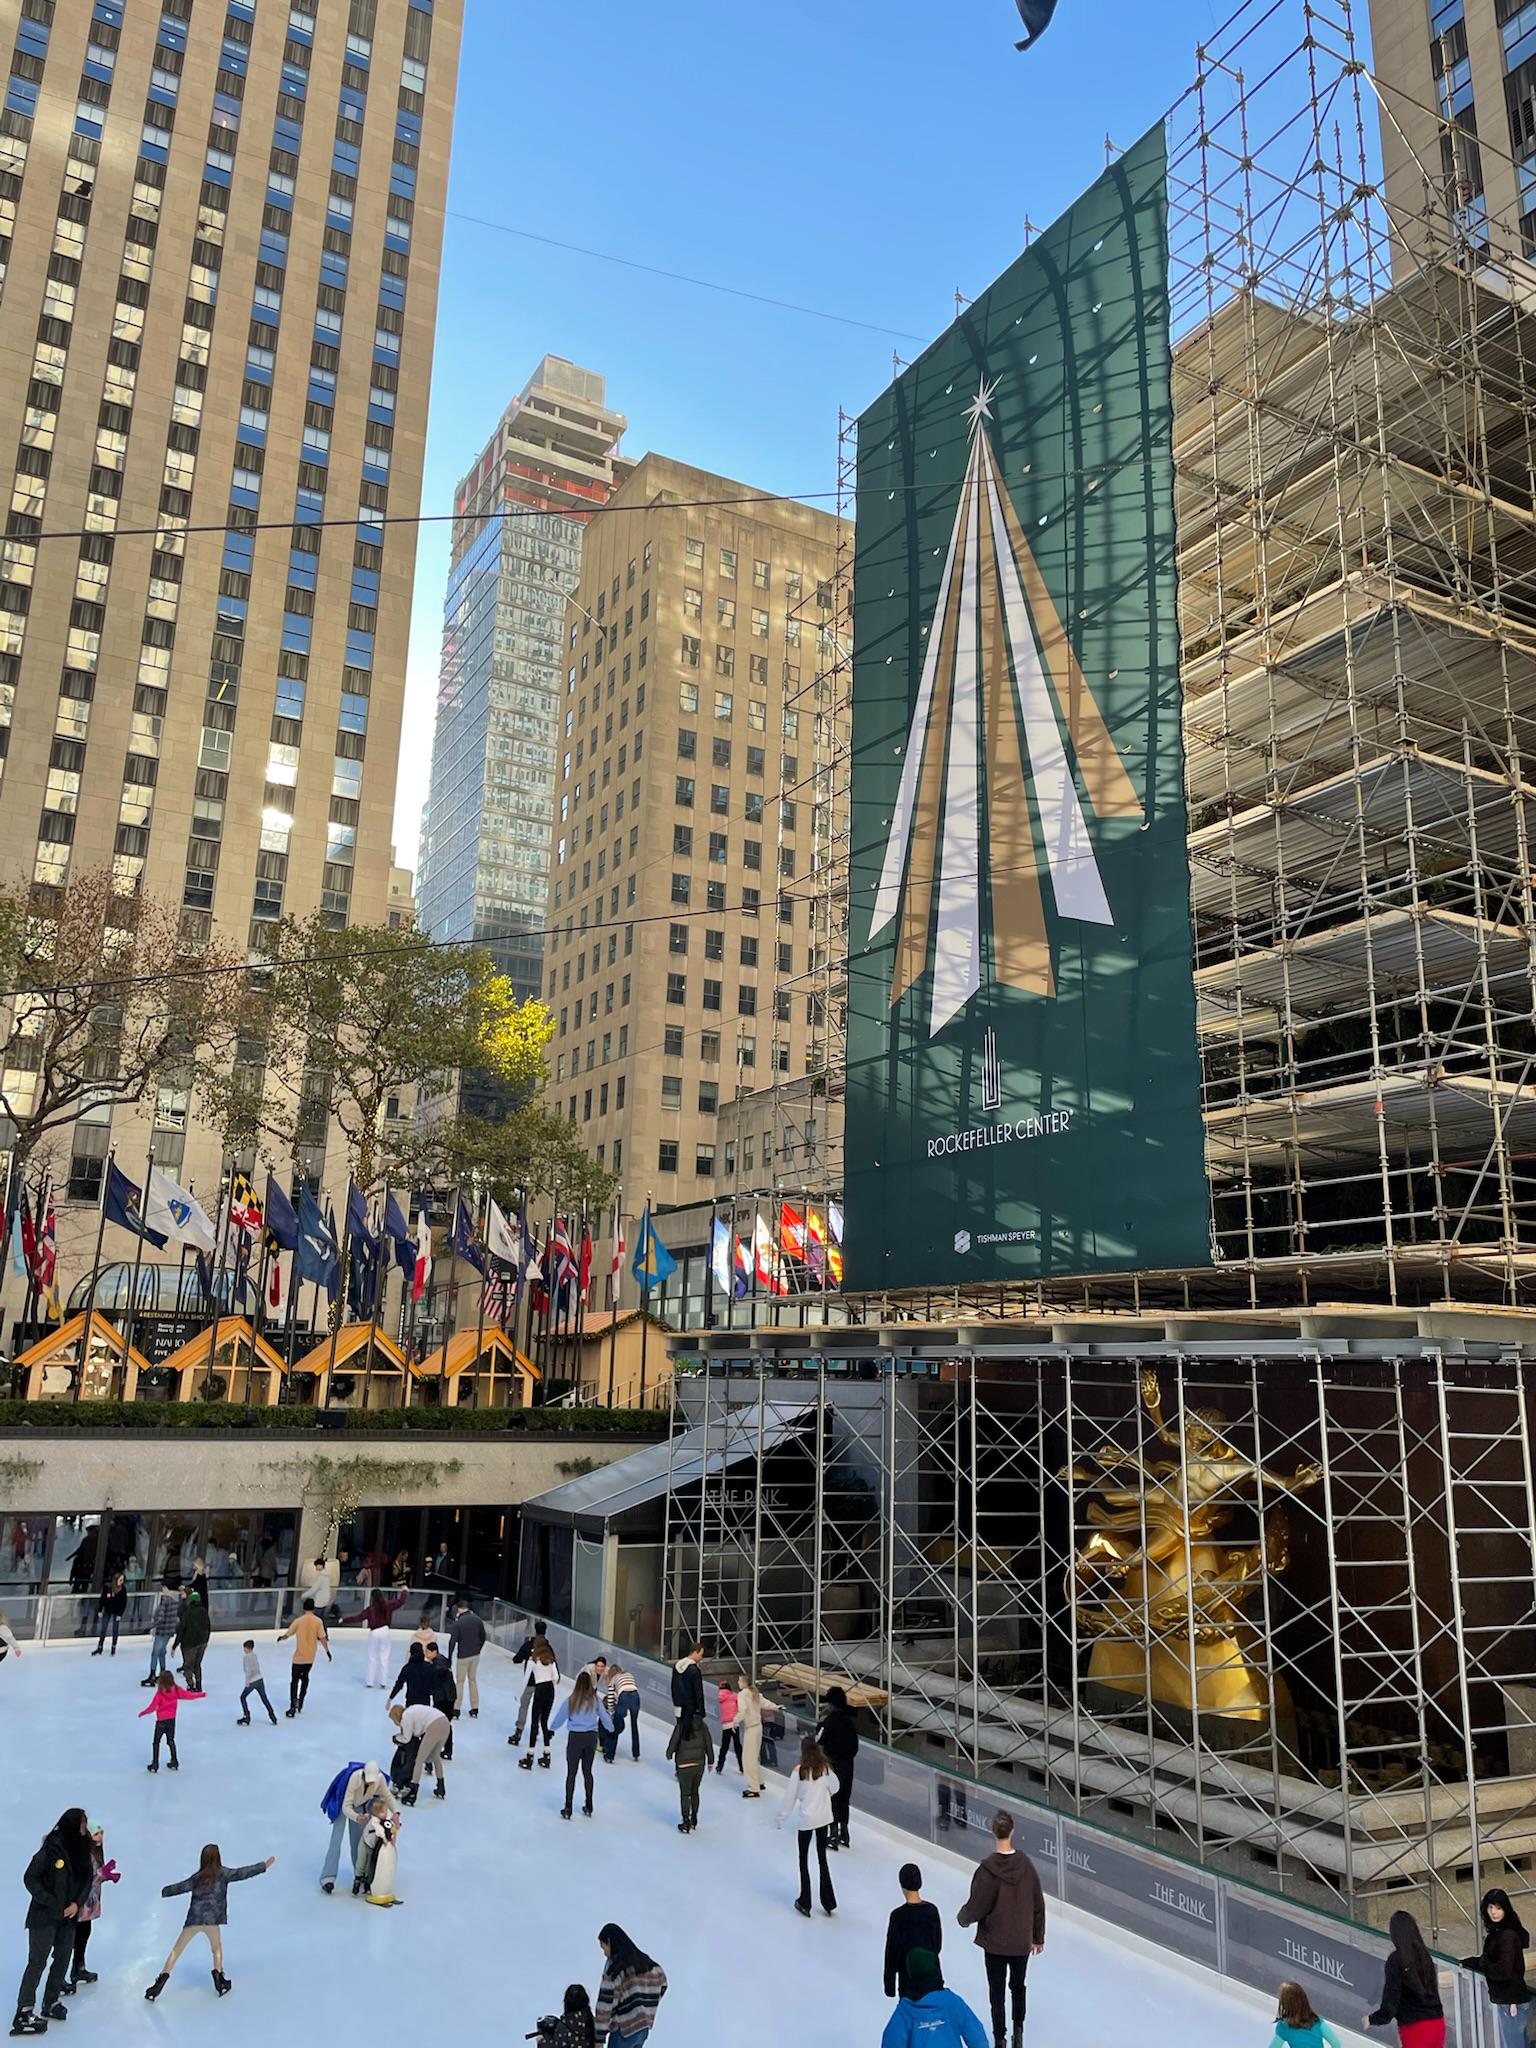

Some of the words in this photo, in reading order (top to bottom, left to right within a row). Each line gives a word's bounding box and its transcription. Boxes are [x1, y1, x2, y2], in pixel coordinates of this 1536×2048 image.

[927, 1123, 1013, 1158] ROCKEFELLER
[949, 1801, 966, 1821] THE
[967, 1809, 989, 1831] RINK
[1043, 1838, 1058, 1856] TH
[1065, 1847, 1091, 1869] RINK
[1154, 1881, 1175, 1905] THE
[1178, 1893, 1207, 1921] RINK
[1283, 1937, 1308, 1964] THE
[1312, 1951, 1346, 1981] RINK
